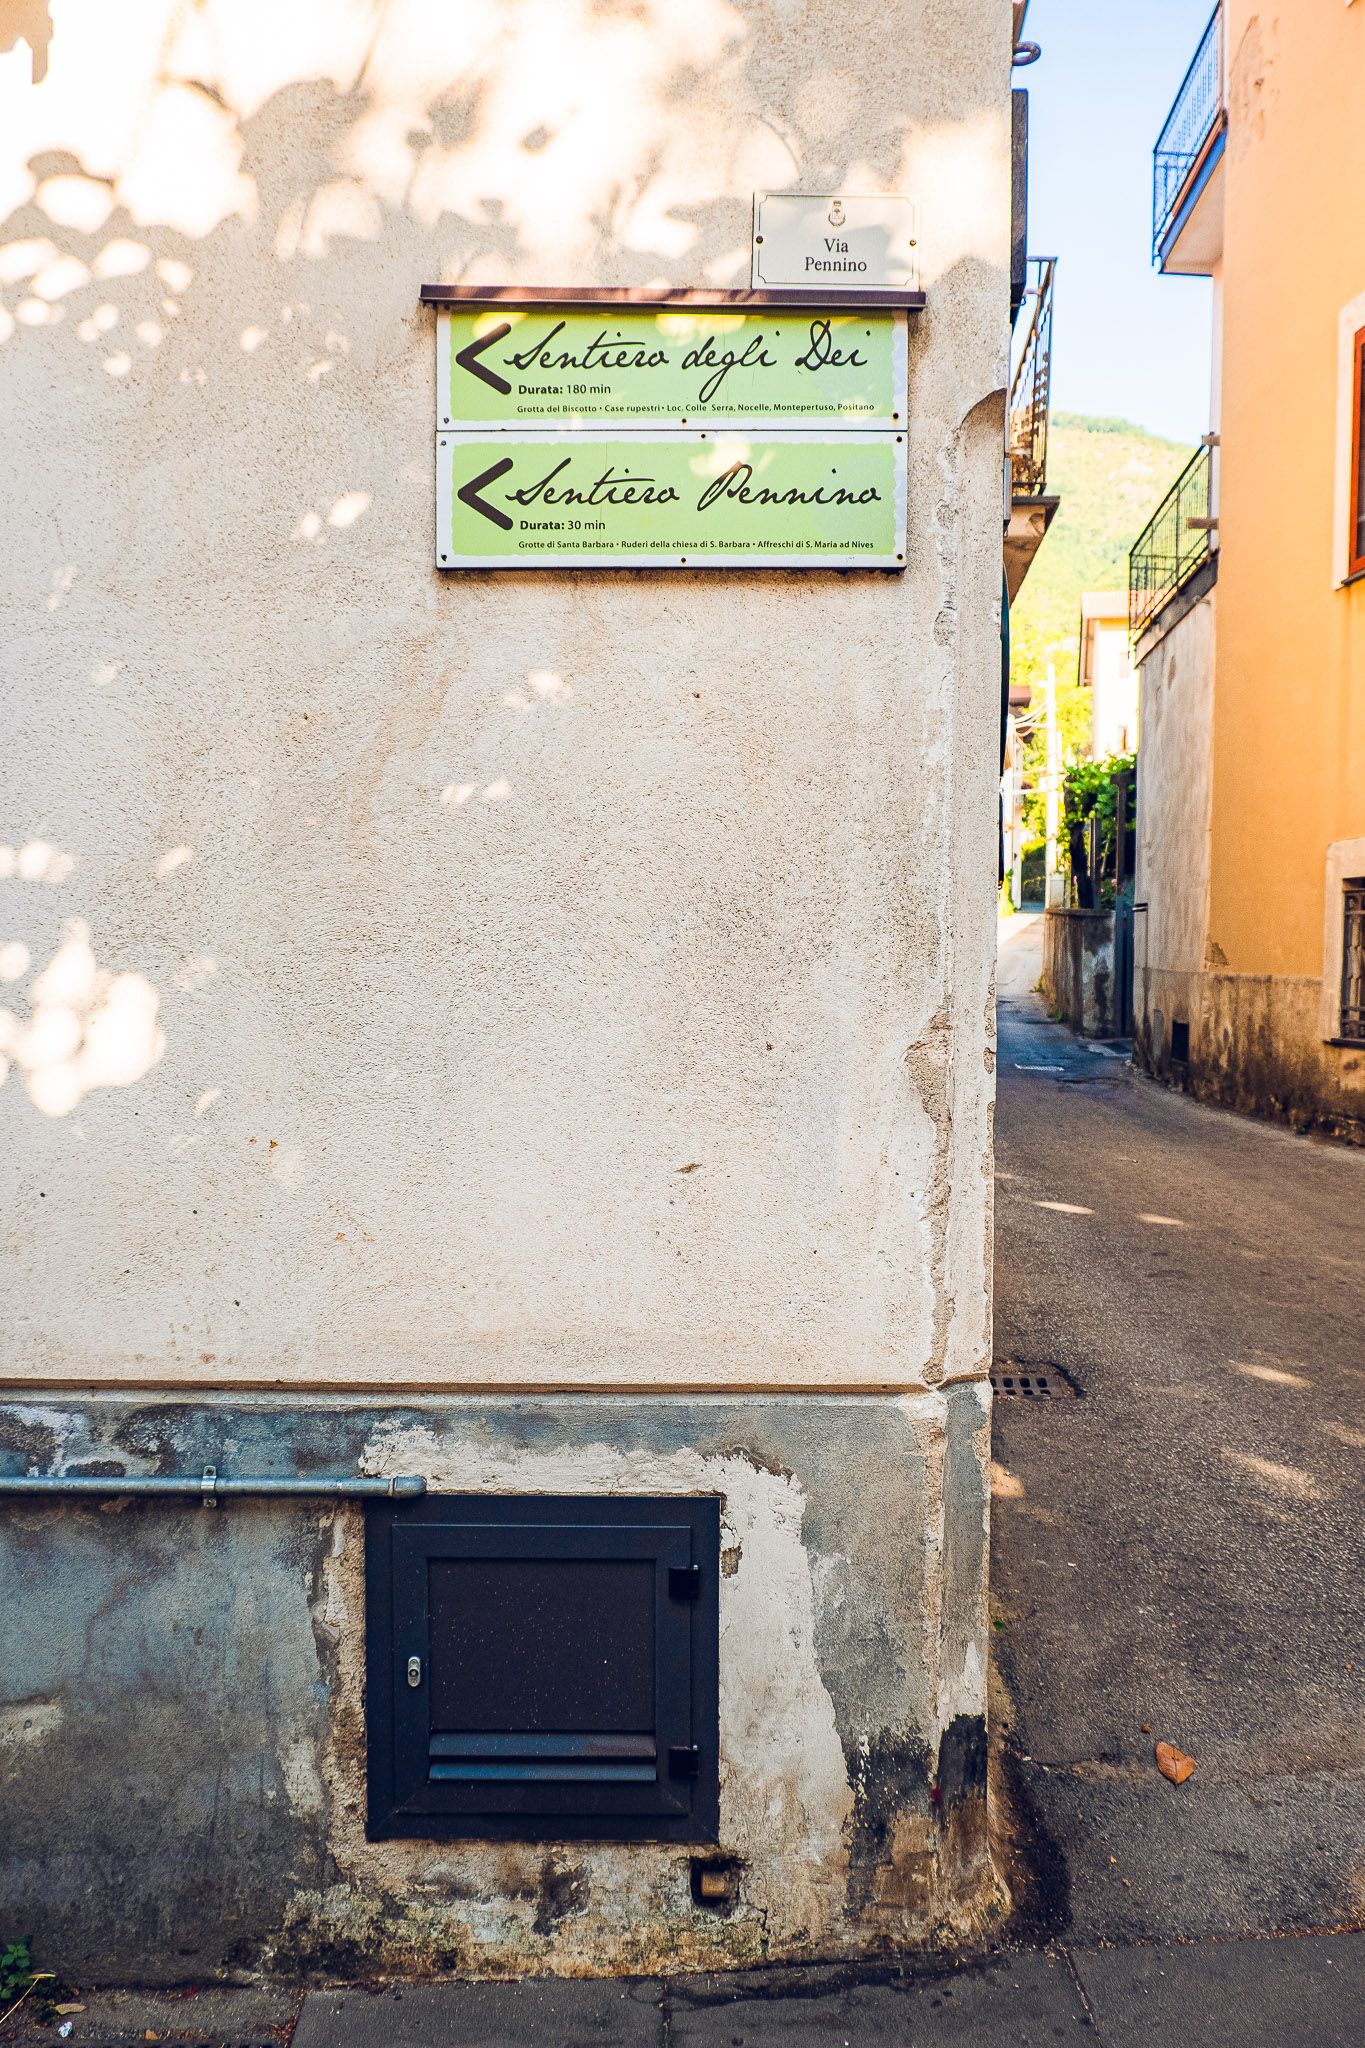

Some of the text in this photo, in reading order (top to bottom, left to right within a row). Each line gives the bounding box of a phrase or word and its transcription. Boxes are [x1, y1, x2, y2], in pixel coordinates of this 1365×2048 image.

[823, 238, 849, 253] Via
[804, 256, 868, 272] Pennino
[503, 319, 872, 403] Sentiero degli Dei
[518, 383, 612, 395] Durata: 180 min
[517, 403, 875, 413] Grotta del Biscotto Case rupestri Loc. Colle Serra, Nocelle, Montepertuso, Positano
[505, 457, 882, 512] Sentiero Pennino
[520, 519, 606, 530] Durata: 30 min
[518, 540, 874, 549] Grotte di Santa Barbara Ruderi della chiesa di S. Barbara Affreschi di S. Maria ad Nives
